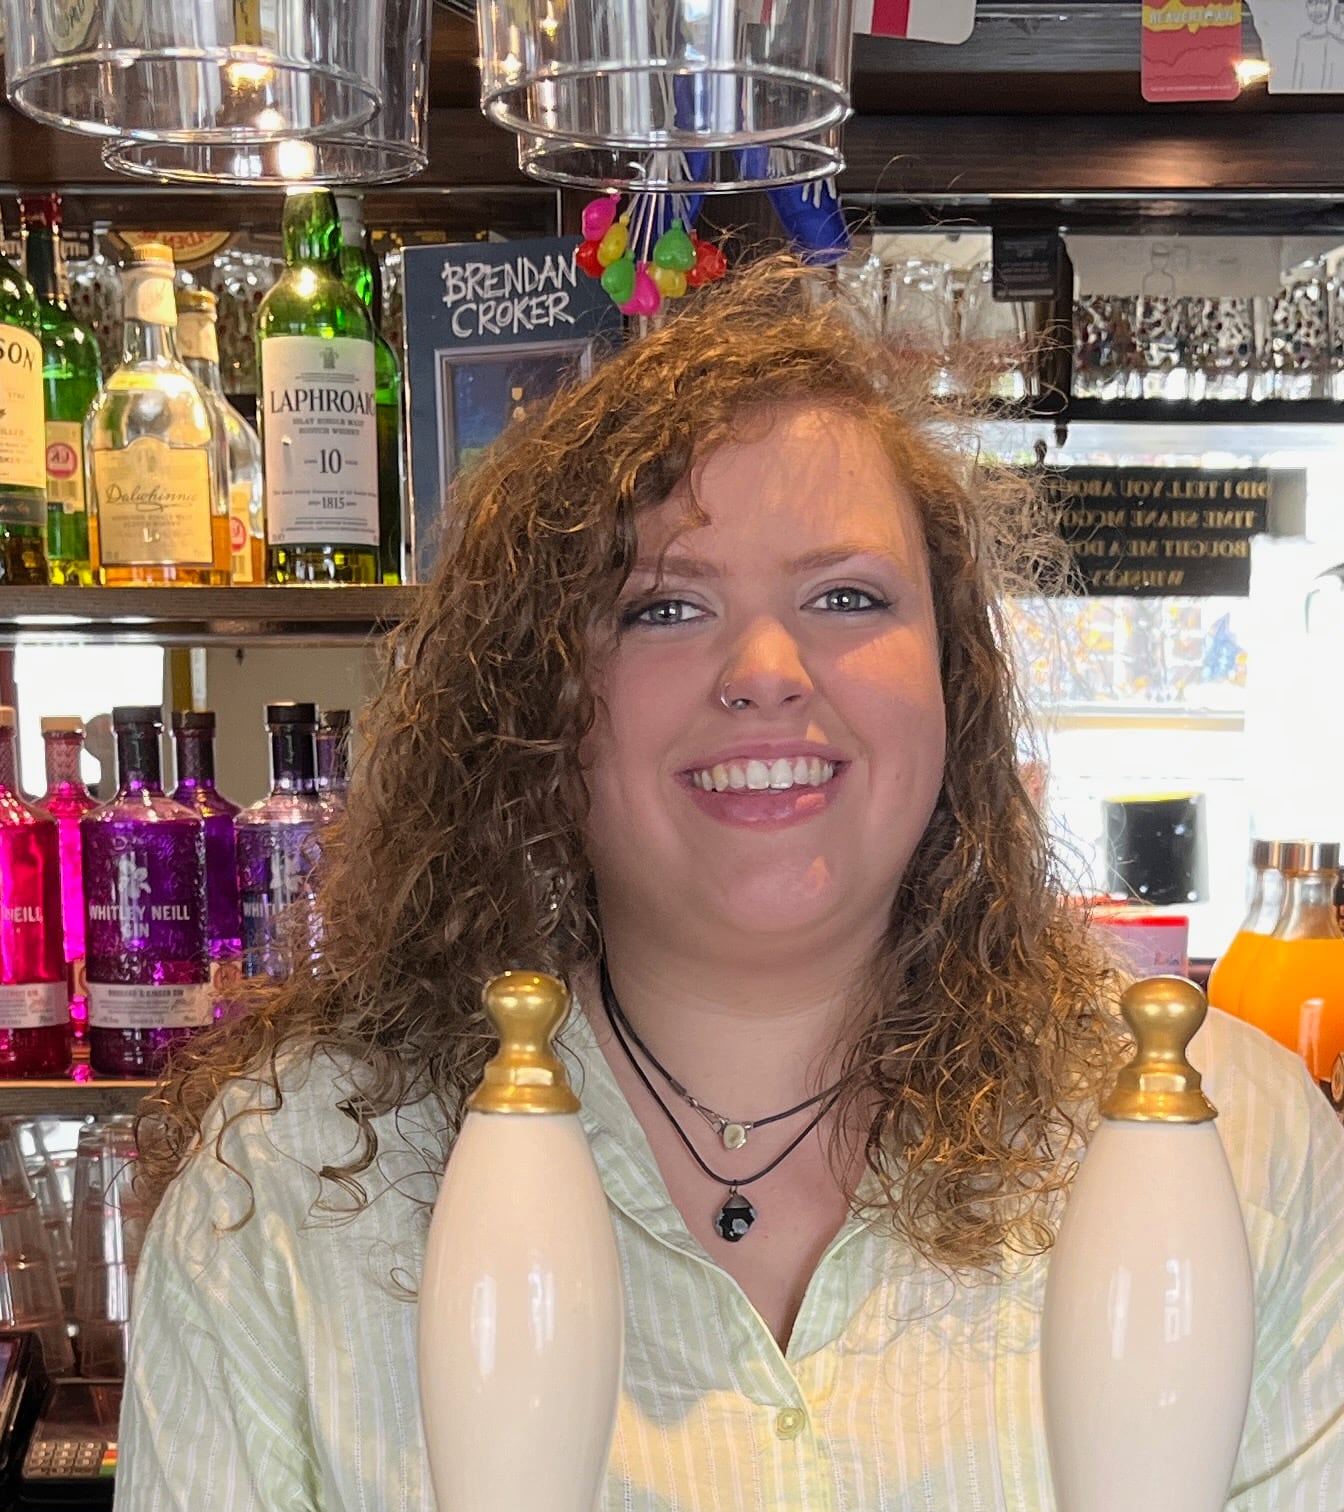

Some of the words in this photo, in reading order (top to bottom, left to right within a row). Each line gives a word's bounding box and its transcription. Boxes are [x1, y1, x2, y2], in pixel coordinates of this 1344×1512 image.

[441, 255, 578, 306] BRENDAN
[452, 293, 575, 338] CROKER
[319, 449, 343, 474] 10
[89, 904, 147, 922] WHITLEY
[151, 904, 191, 922] NEILL
